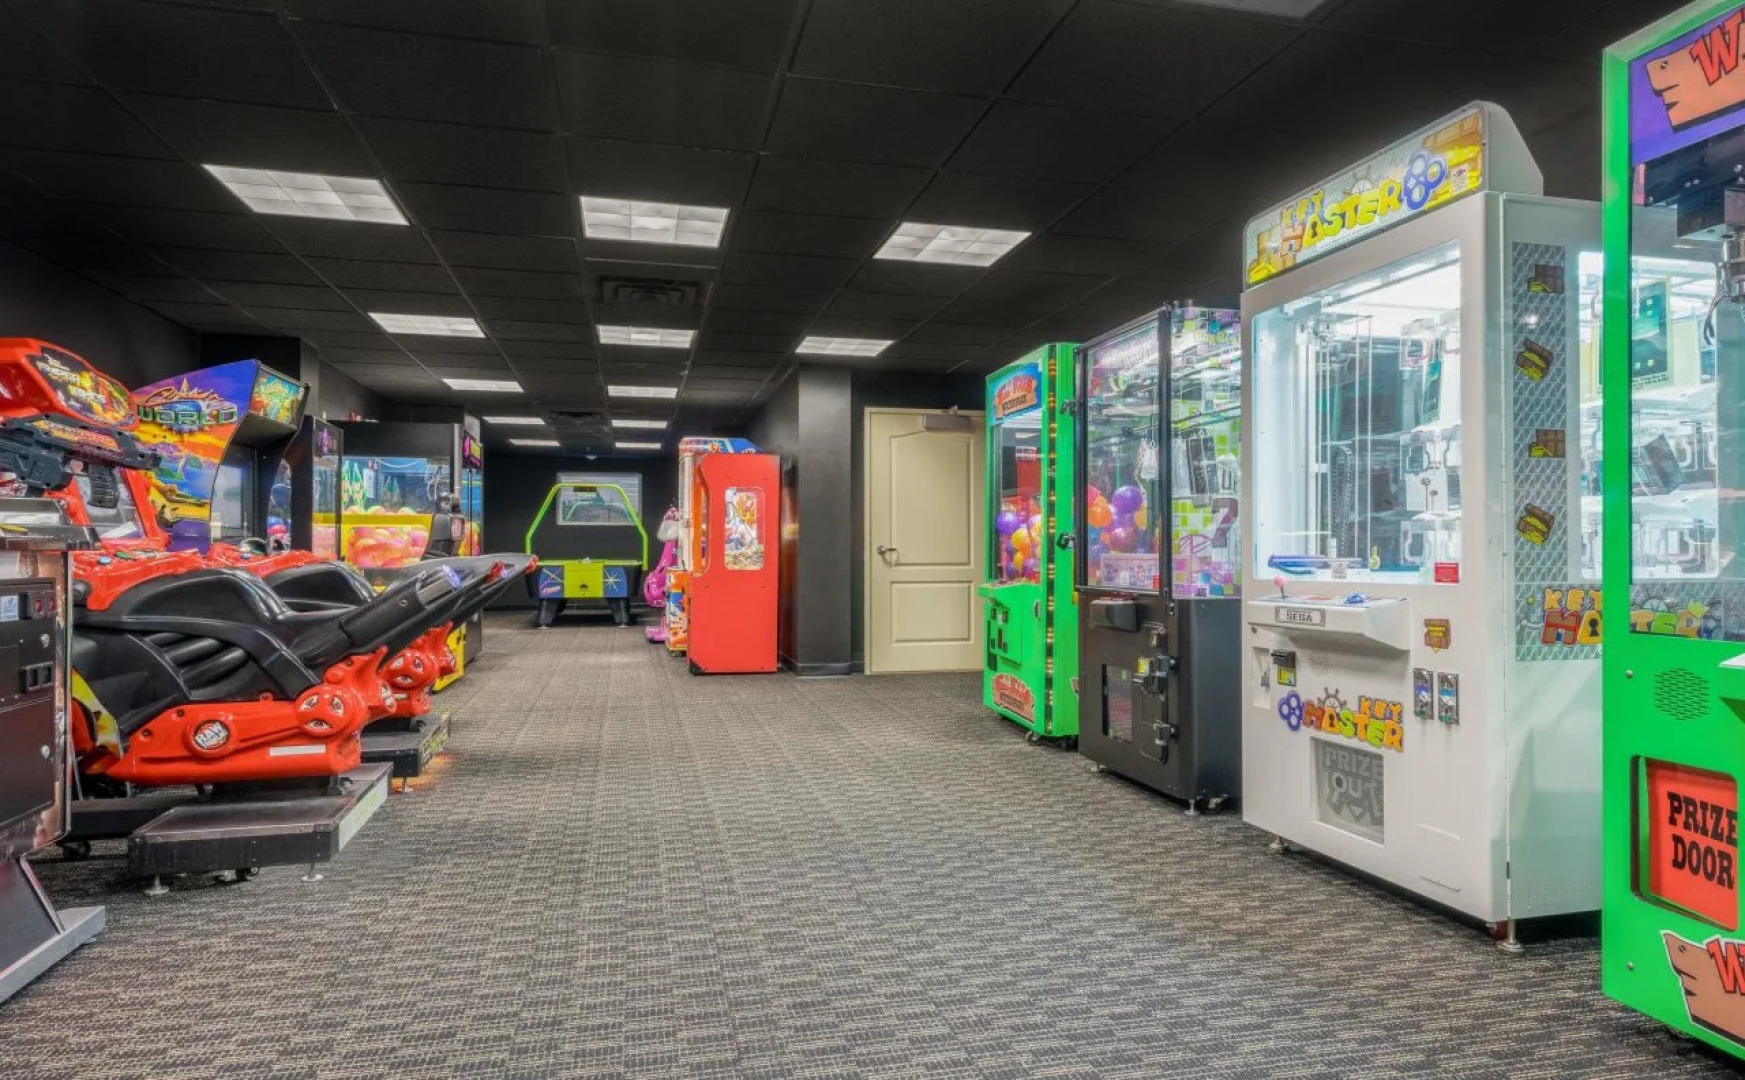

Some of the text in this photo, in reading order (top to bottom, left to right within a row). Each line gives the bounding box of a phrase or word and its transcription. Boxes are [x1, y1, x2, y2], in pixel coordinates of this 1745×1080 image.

[1280, 179, 1403, 254] MASTER
[1281, 189, 1325, 225] KEY
[136, 403, 238, 426] WORLD
[1286, 610, 1313, 622] SEGA
[1302, 700, 1404, 752] MASTER
[1358, 695, 1403, 724] KEY
[1324, 749, 1384, 780] PRIZE
[1667, 791, 1738, 849] PRIZE
[1672, 833, 1735, 890] DOOR
